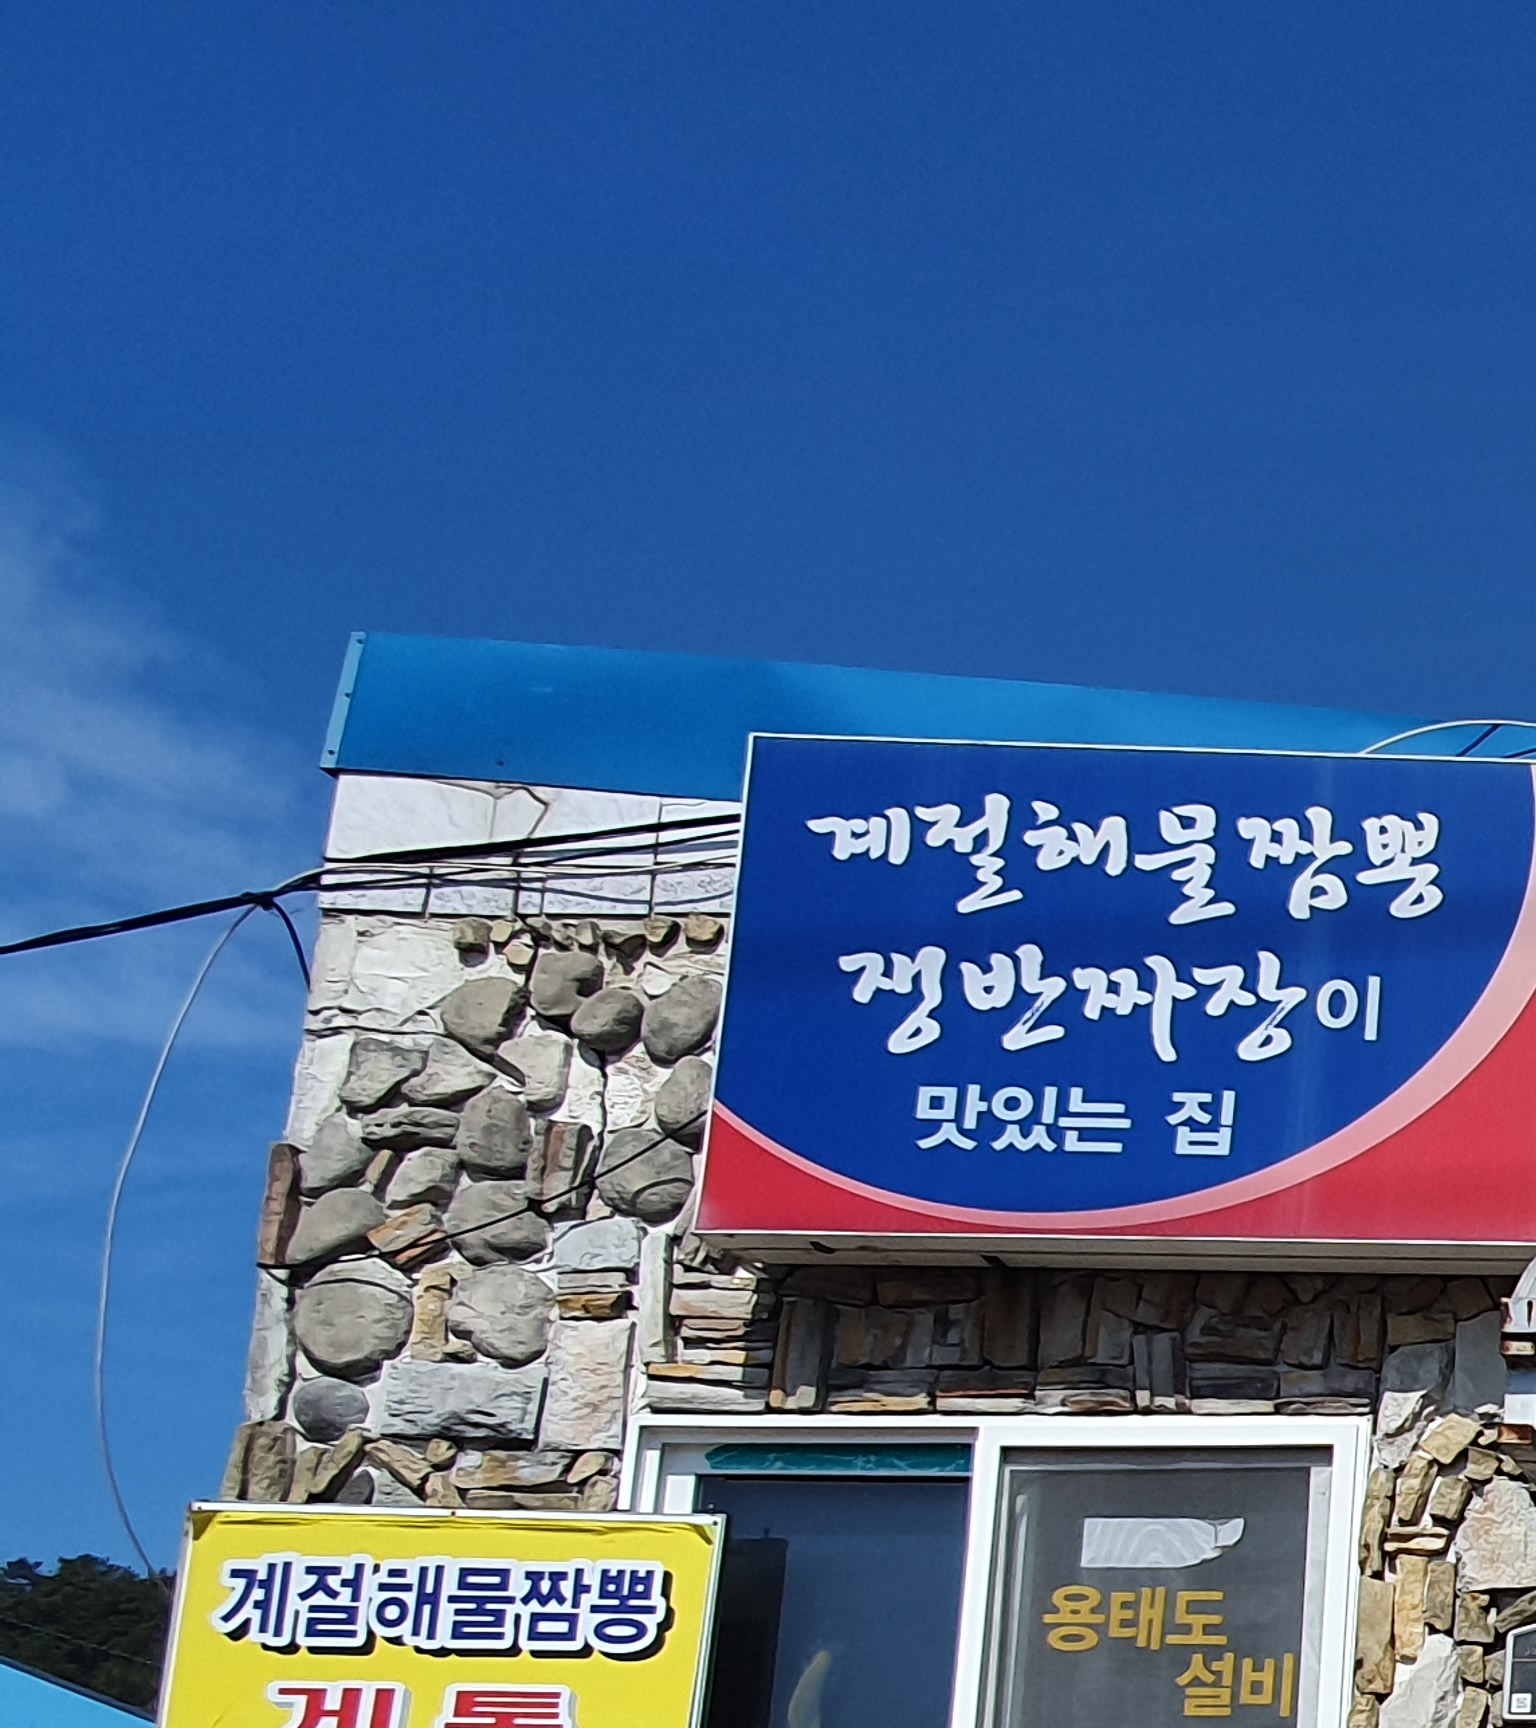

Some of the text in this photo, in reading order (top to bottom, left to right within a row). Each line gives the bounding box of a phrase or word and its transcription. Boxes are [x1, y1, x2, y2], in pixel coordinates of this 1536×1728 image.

[805, 791, 1445, 926] 계절해물짬뽕
[838, 943, 1382, 1063] 쟁반짜장이
[915, 1083, 1237, 1157] 맛있는 집
[220, 1560, 661, 1648] 계절해물짬뽕
[1042, 1584, 1228, 1652] 용태도
[1174, 1651, 1296, 1718] 설비
